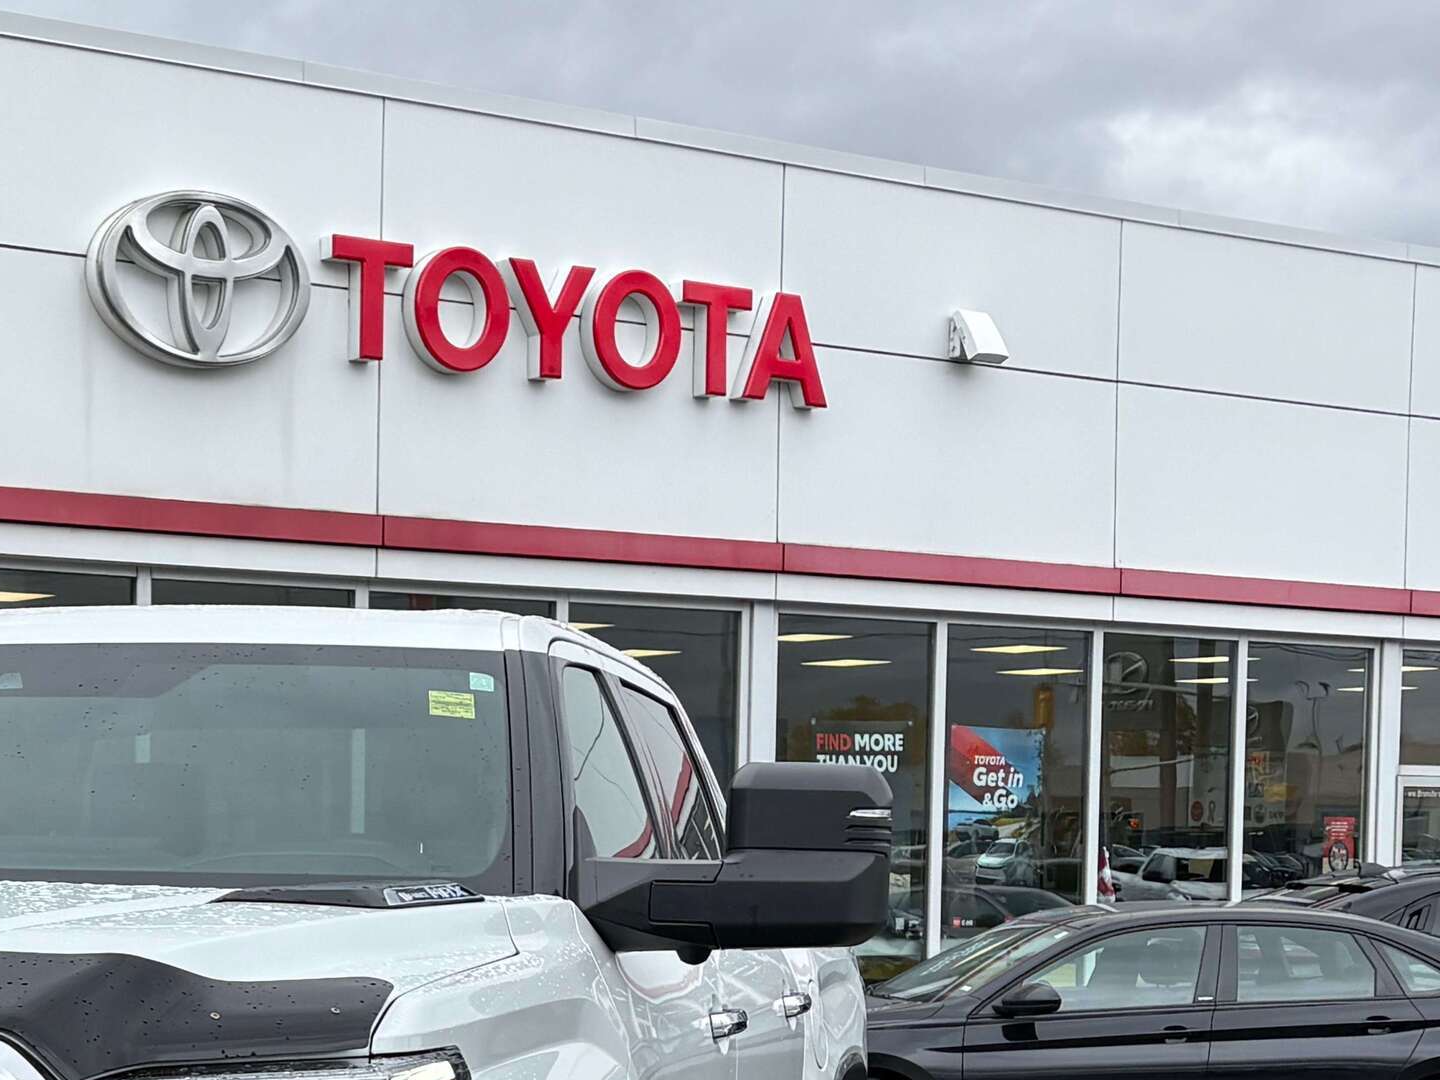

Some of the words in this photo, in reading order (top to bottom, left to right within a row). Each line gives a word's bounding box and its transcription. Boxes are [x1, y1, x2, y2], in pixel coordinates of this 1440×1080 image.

[320, 233, 828, 410] TOYOTA
[816, 733, 852, 751] FIND
[854, 733, 904, 752] MORE
[863, 754, 898, 773] YOU
[974, 755, 1006, 766] TOYOTA
[973, 766, 1005, 787] Get
[1007, 767, 1024, 788] in
[982, 789, 1018, 809] &Go
